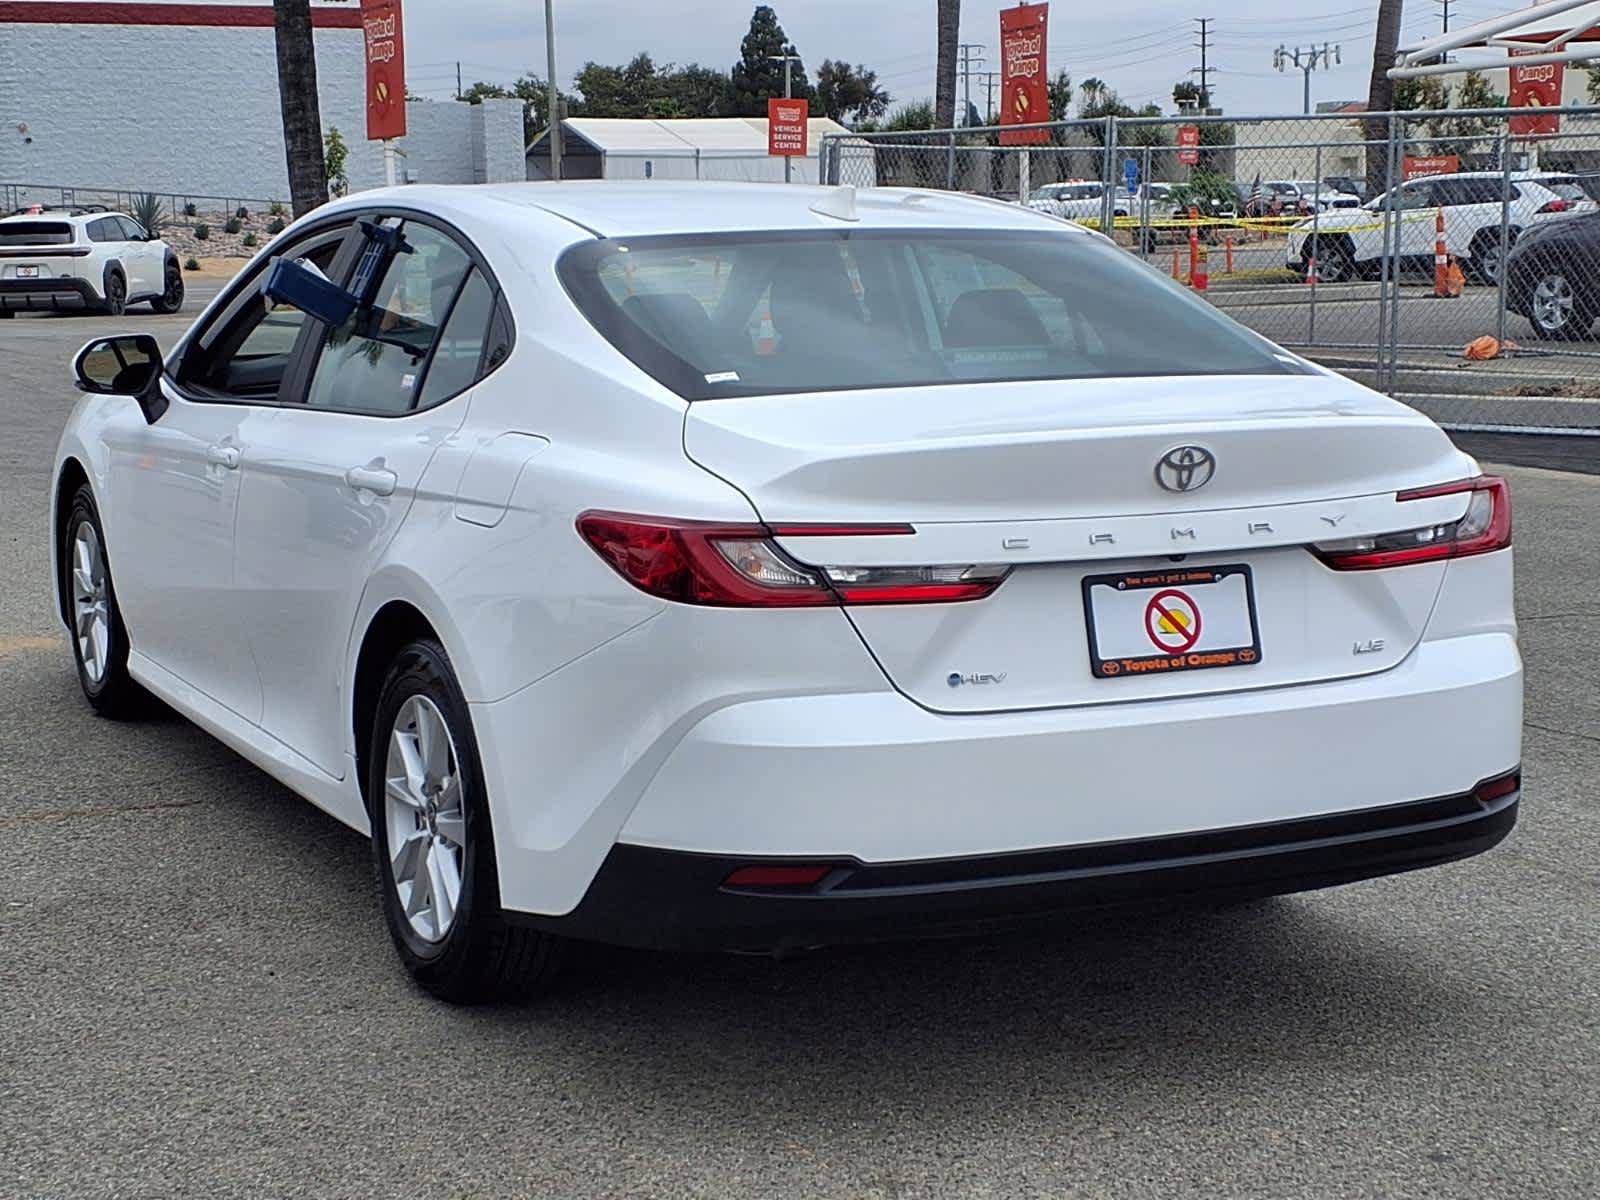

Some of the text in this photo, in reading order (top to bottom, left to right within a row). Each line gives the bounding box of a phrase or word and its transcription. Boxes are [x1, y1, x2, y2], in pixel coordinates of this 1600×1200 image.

[384, 14, 395, 35] of
[1005, 34, 1041, 60] Toyota of
[1008, 58, 1039, 78] Orange
[1517, 65, 1554, 83] Orange
[1003, 514, 1345, 550] CAMRY
[1125, 577, 1141, 586] You
[1353, 639, 1385, 656] LE
[1121, 652, 1235, 672] Toyota of Orange
